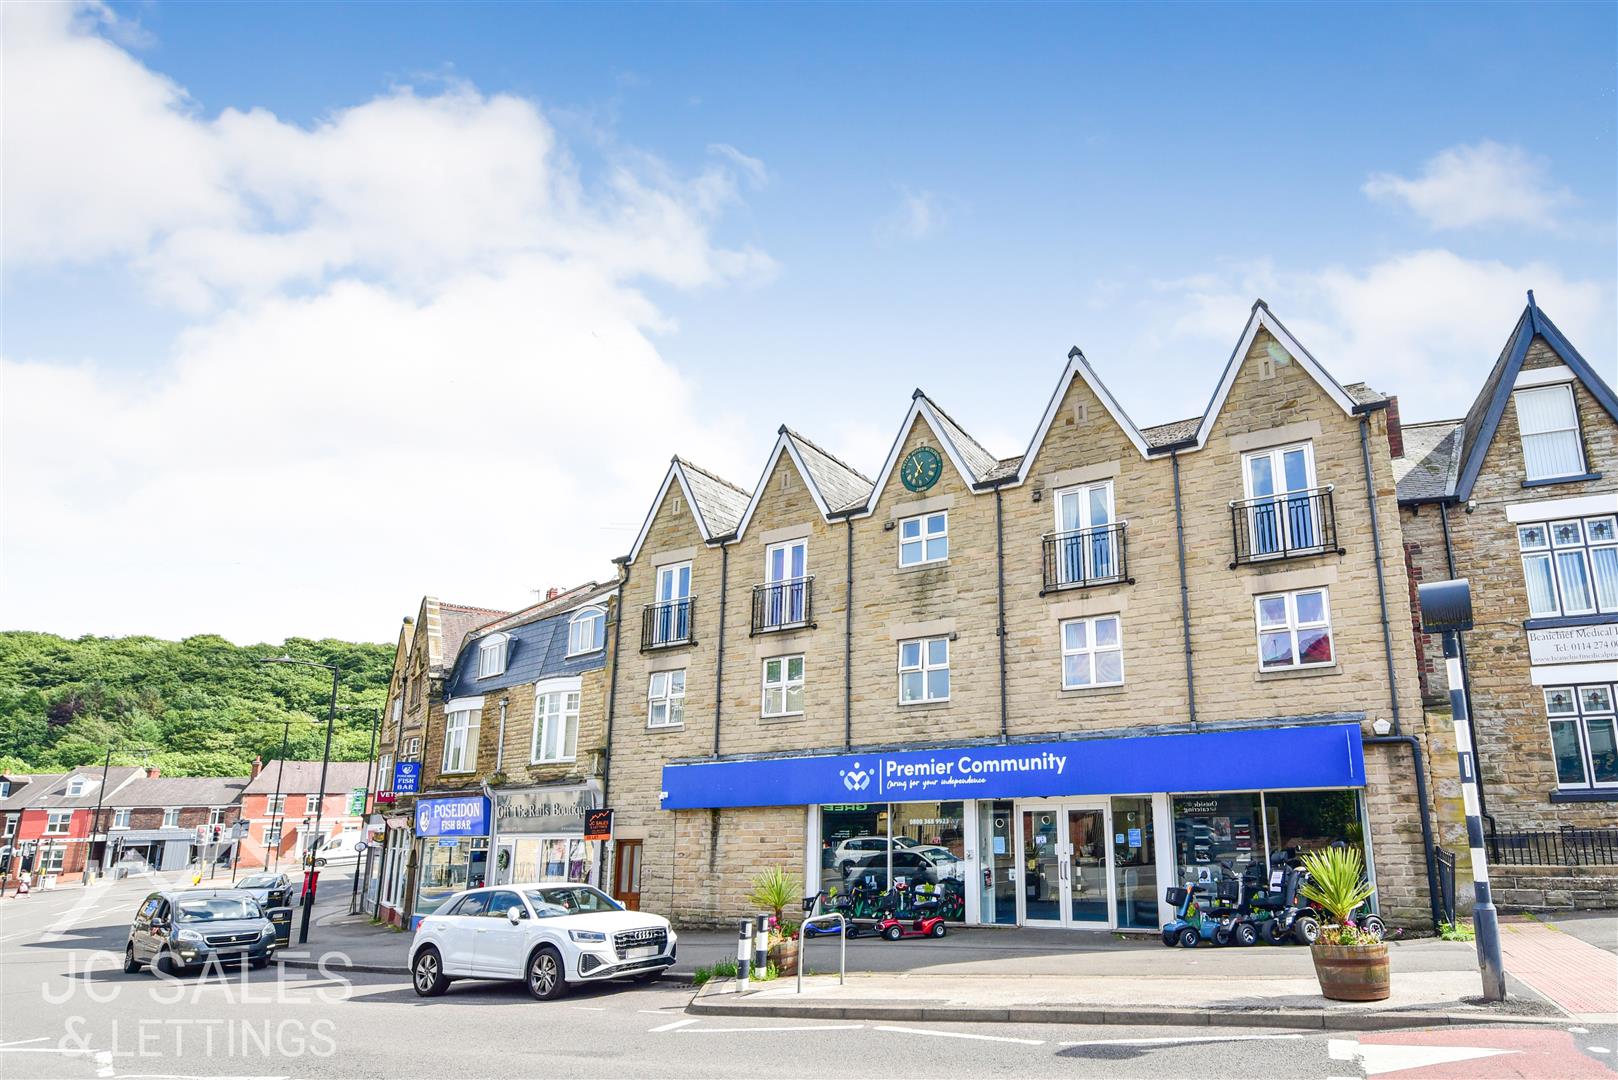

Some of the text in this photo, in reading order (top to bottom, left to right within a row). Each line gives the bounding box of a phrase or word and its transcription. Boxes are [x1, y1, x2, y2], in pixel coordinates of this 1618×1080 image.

[1529, 627, 1612, 642] Beauchief Medical
[1571, 642, 1591, 651] 0114
[1594, 640, 1609, 650] 274
[886, 752, 1067, 777] Premier Community
[886, 775, 987, 791] Caring for your independence
[434, 802, 481, 818] POSEIDON
[497, 804, 513, 819] Off
[512, 804, 529, 818] The
[529, 803, 551, 817] Rails
[441, 819, 471, 831] FISH BAR
